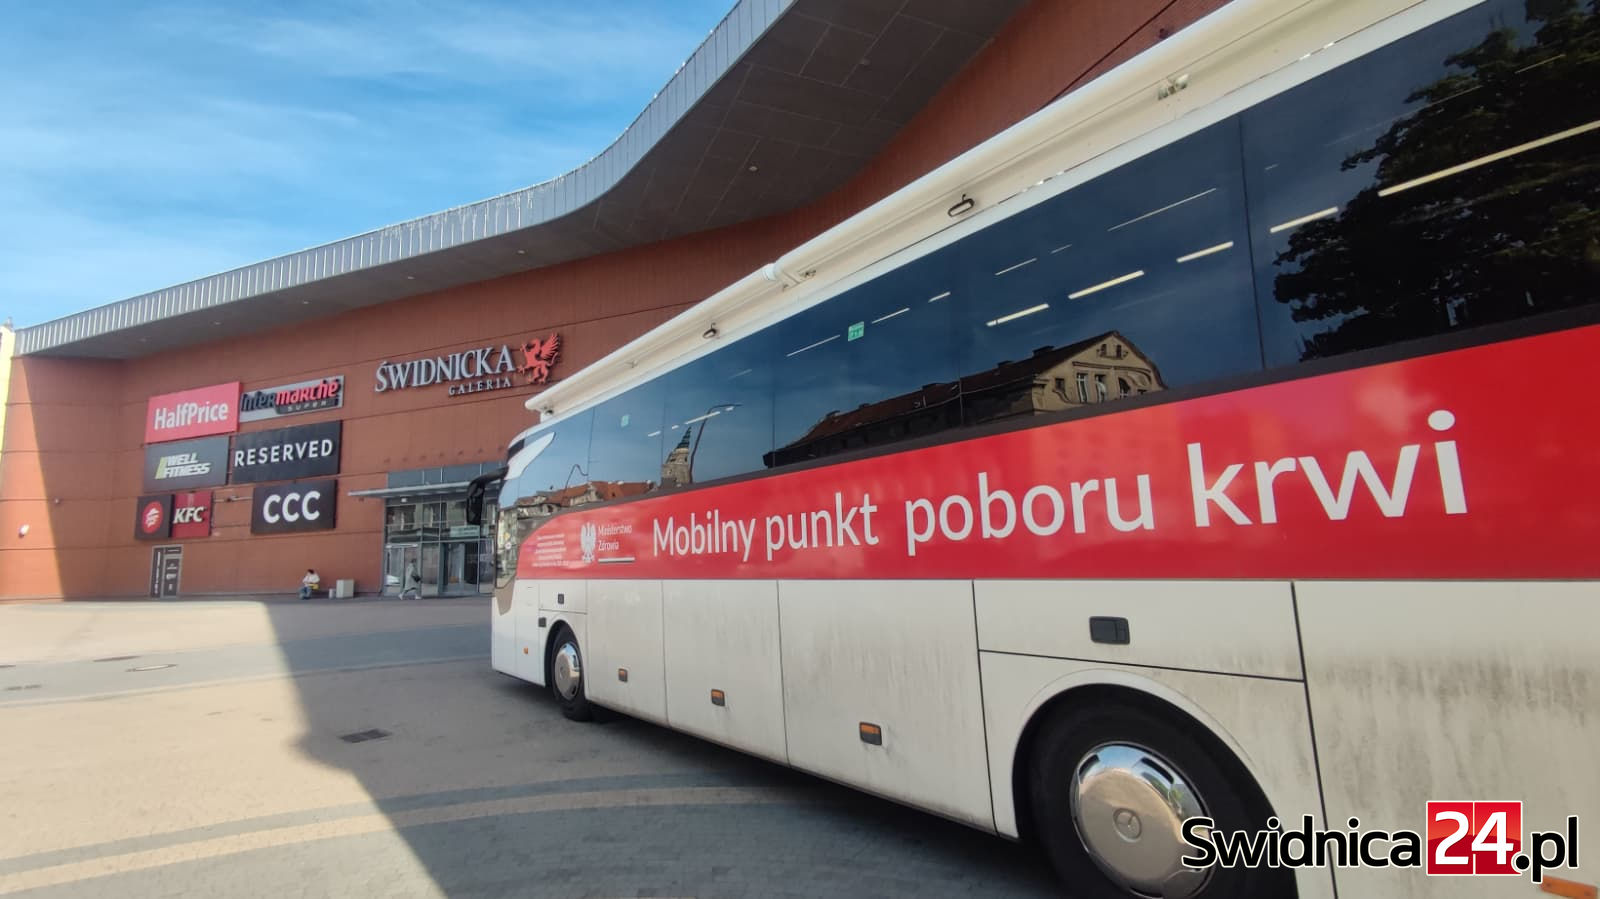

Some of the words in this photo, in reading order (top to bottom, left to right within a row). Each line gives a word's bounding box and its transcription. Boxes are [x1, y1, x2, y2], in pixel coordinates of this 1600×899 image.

[374, 344, 516, 393] ŚWIDNICKA
[448, 378, 512, 396] GALERIA
[154, 401, 229, 430] HalfPrice
[167, 453, 199, 467] WELL
[234, 439, 333, 468] RESERVED
[163, 462, 212, 478] FITNESS
[652, 508, 756, 562] Mobilny
[766, 492, 879, 562] punkt
[905, 471, 1155, 557] poboru
[1187, 409, 1468, 528] krwi
[172, 506, 205, 524] KFC
[263, 490, 321, 523] CCC
